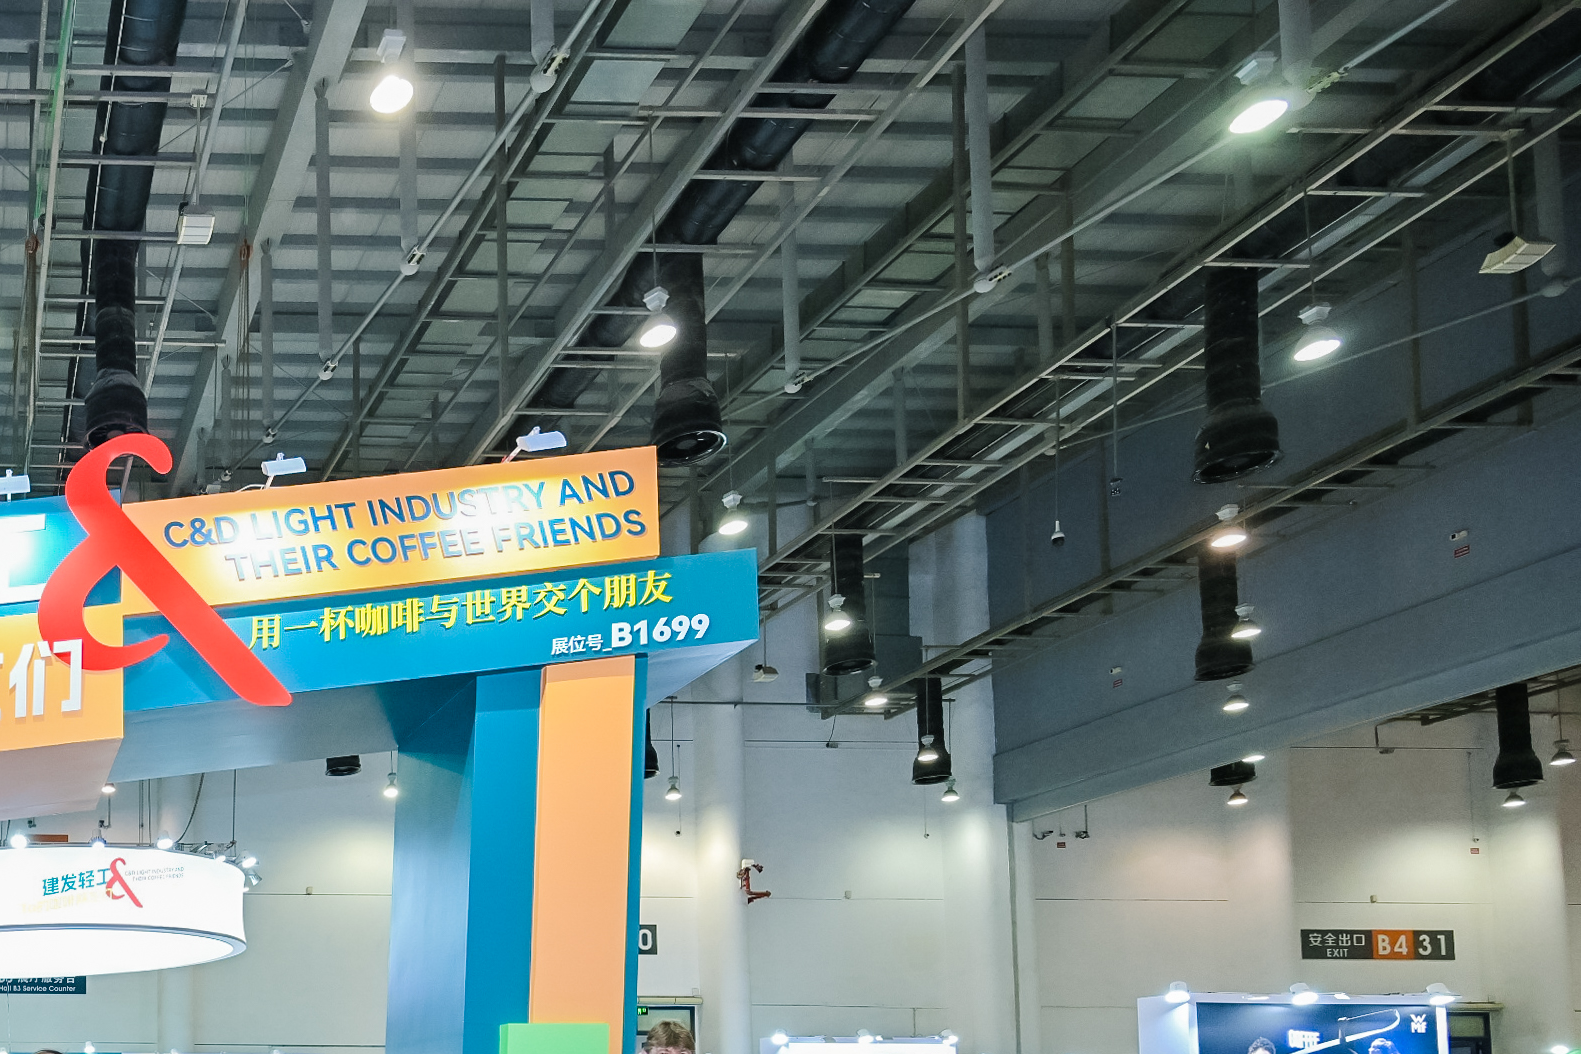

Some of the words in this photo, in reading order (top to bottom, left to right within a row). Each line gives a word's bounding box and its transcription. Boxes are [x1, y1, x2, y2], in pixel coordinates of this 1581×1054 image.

[163, 514, 240, 550] C&D
[249, 502, 356, 543] LIGHT
[369, 481, 545, 526] INDUSTRY
[558, 468, 637, 505] AND
[225, 541, 340, 582] THEIR
[345, 526, 485, 567] COFFEE
[493, 507, 648, 554] FRIENDS
[248, 570, 674, 652] 用一杯咖啡与世界交个朋友
[41, 867, 110, 897] 建发轻工
[1308, 933, 1365, 947] 安全出口
[1326, 948, 1349, 958] EXIT
[1377, 934, 1409, 956] B4
[1418, 934, 1447, 956] 31
